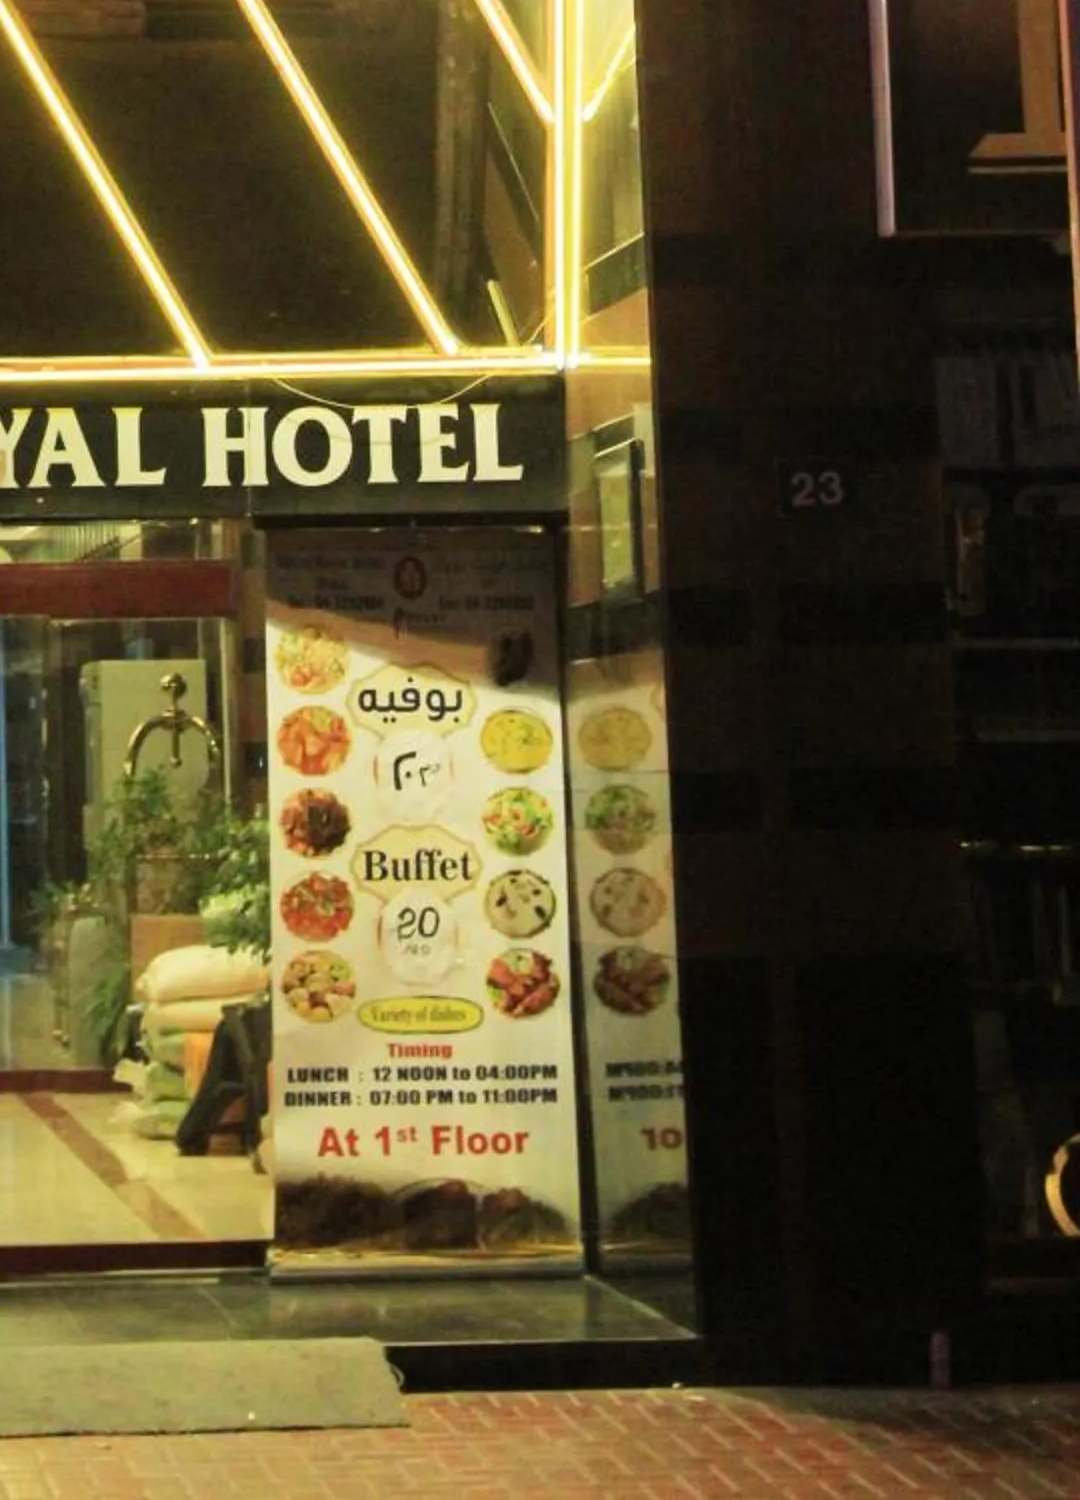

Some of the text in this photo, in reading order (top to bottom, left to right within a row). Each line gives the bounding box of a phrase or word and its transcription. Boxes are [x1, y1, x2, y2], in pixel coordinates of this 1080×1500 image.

[201, 403, 523, 487] HOTEL
[791, 471, 844, 507] 23
[358, 677, 463, 723] بوفيه
[363, 849, 472, 882] Buffet
[397, 906, 441, 940] 20
[387, 1043, 453, 1059] Timing
[287, 1067, 349, 1084] LUNCH
[372, 1066, 392, 1083] 12
[396, 1065, 448, 1082] NOON
[452, 1066, 471, 1081] to
[475, 1064, 558, 1081] 04:00PM
[284, 1091, 352, 1108] DINNER
[369, 1089, 421, 1107] 07:00
[425, 1089, 454, 1105] PM
[458, 1090, 478, 1105] to
[482, 1088, 558, 1104] 11:00PM
[318, 1123, 529, 1157] At 1st Floor
